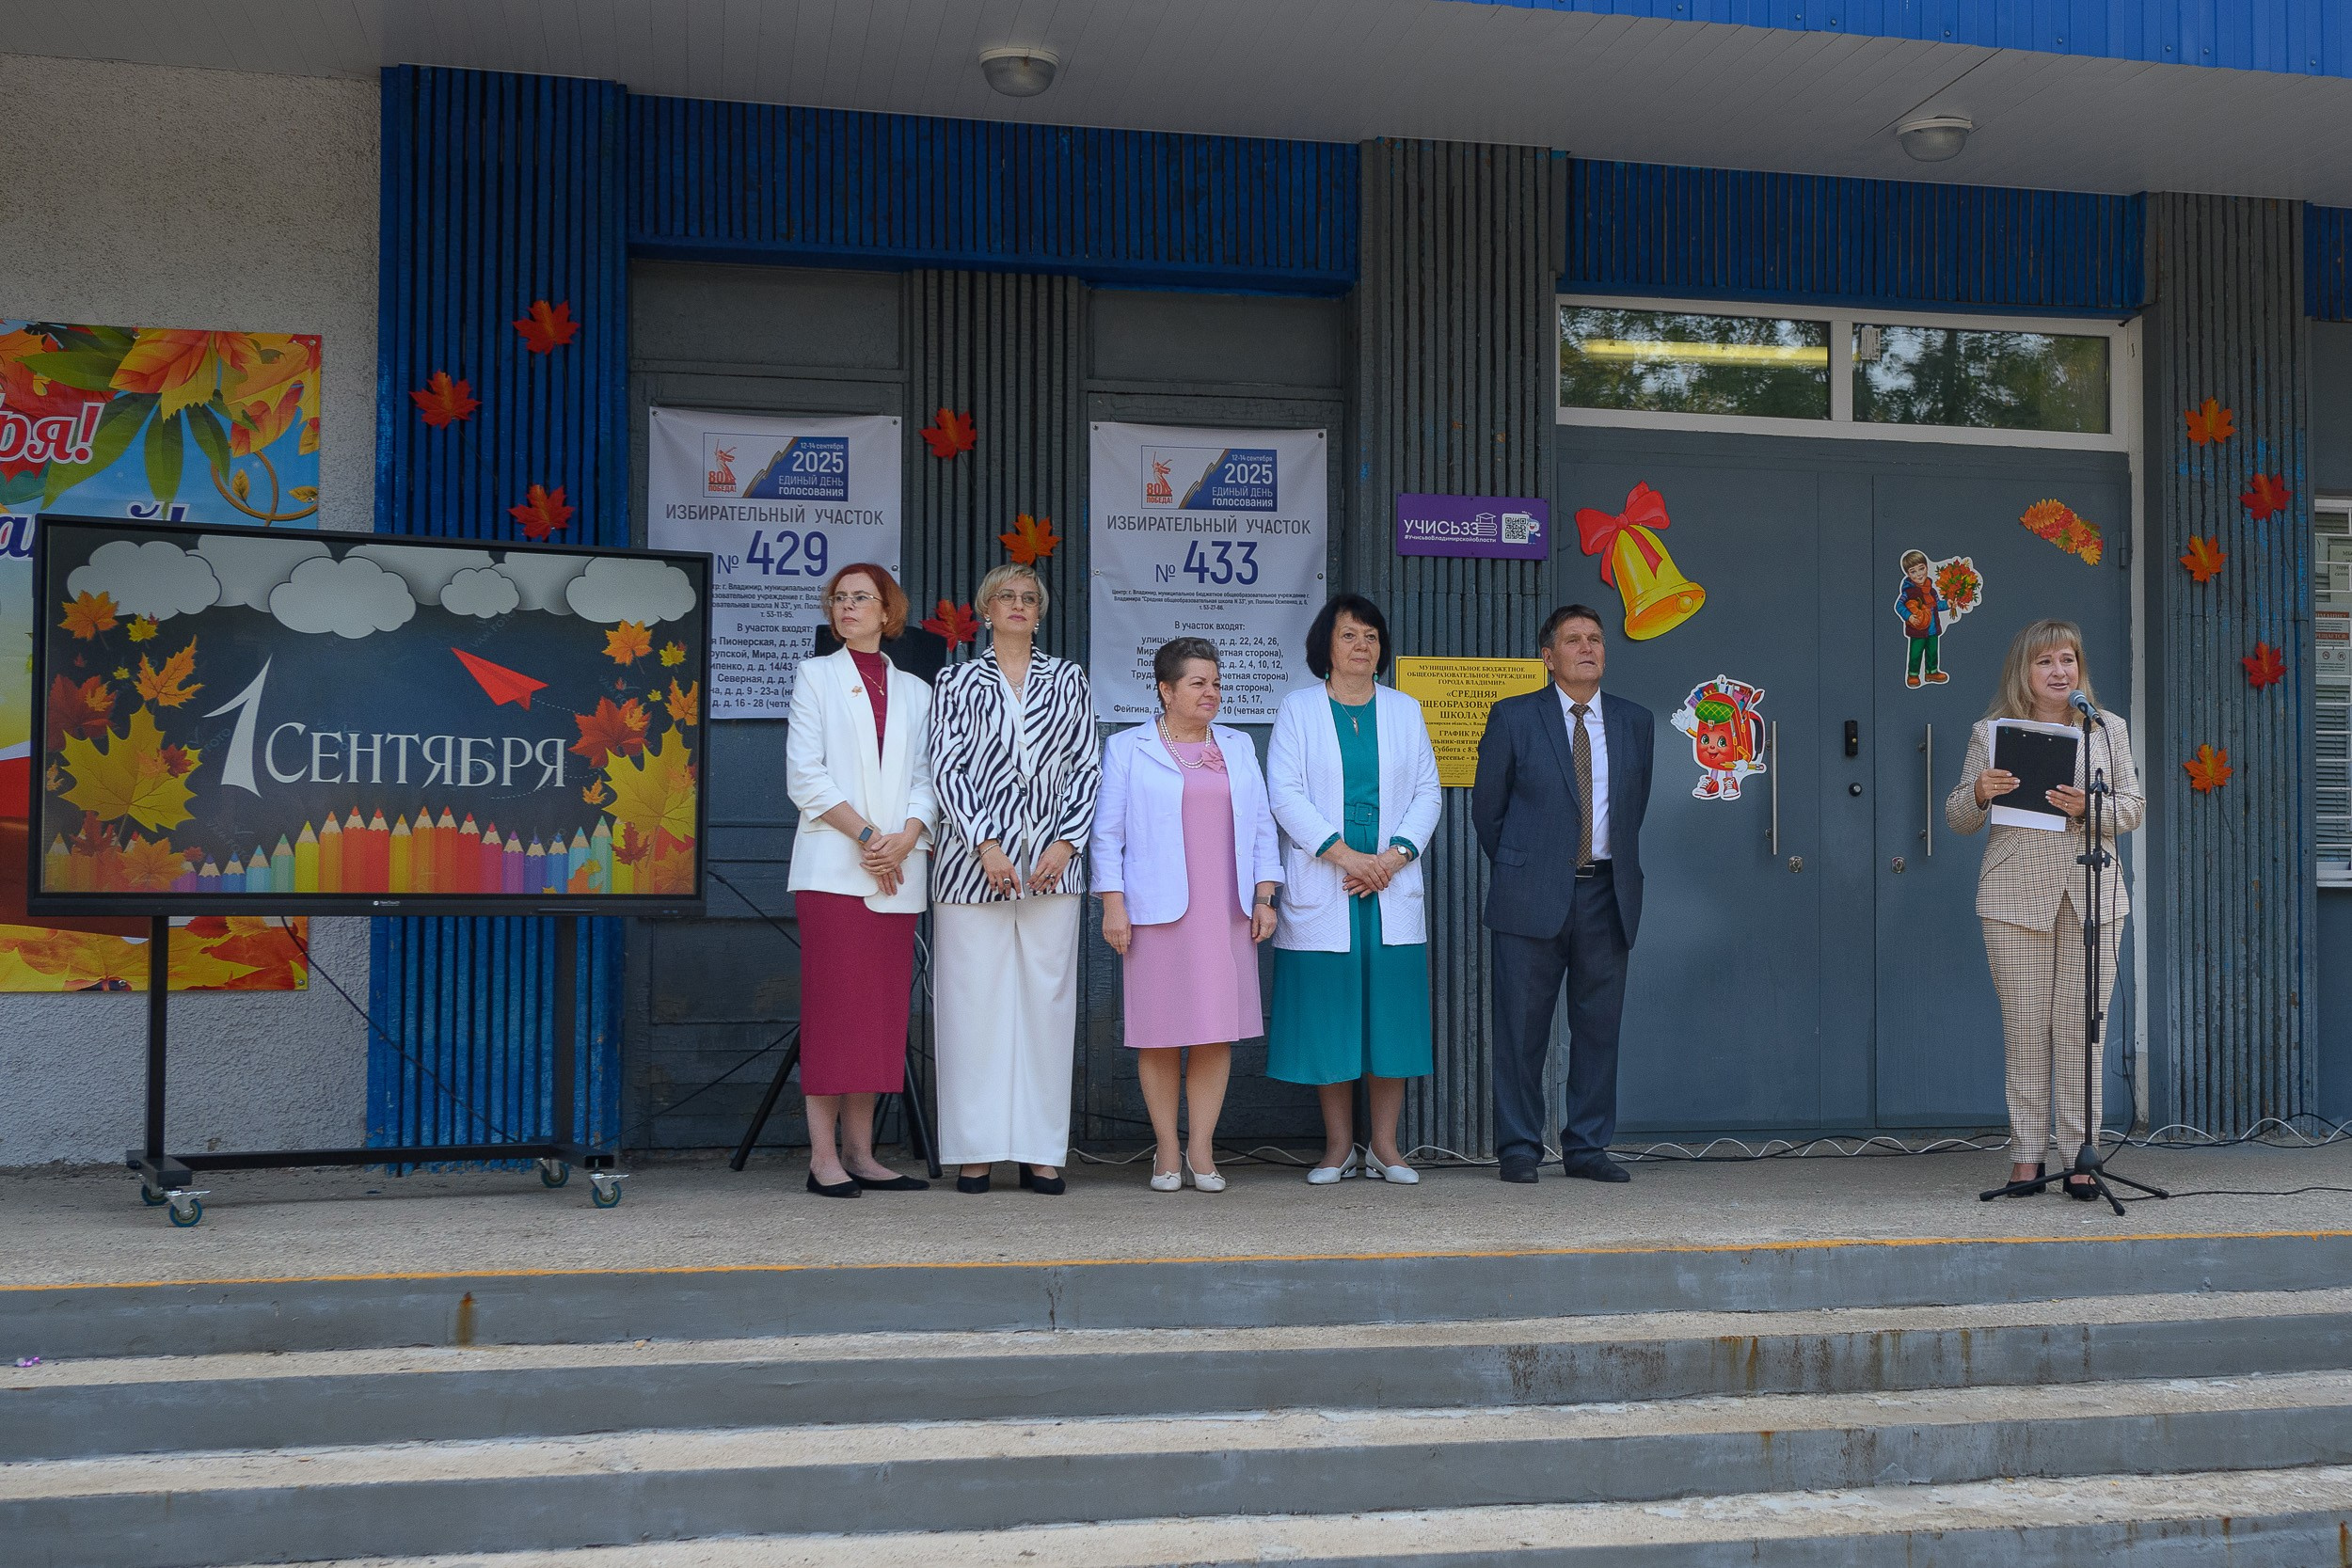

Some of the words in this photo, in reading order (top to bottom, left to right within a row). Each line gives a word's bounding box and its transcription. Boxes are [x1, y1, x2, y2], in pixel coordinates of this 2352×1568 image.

[816, 442, 845, 451] сентября
[792, 451, 845, 473] 2025
[707, 471, 724, 483] 80
[1224, 464, 1273, 485] 2025
[778, 474, 818, 485] ЕДИНЫЙ
[819, 476, 845, 487] ДЕНЬ
[707, 484, 737, 493] ПОБЕДА!
[1146, 483, 1161, 495] 80
[1212, 485, 1248, 497] ЕДИНЫЙ
[1250, 487, 1274, 499] ДЕНЬ
[1146, 497, 1173, 505] ПОБЕДА!
[666, 503, 806, 523] ИЗБИРАТЕЛЬНЫЙ
[815, 508, 884, 526] УЧАСТОК
[1107, 515, 1238, 533] ИЗБИРАТЕЛЬНЫЙ
[1246, 518, 1311, 534] УЧАСТОК
[718, 554, 739, 575] №
[746, 530, 828, 577] 429
[1155, 564, 1176, 583] №
[1183, 540, 1259, 585] 433
[764, 585, 817, 594] муниципальное
[757, 594, 799, 603] учреждение
[737, 623, 744, 632] В
[744, 626, 781, 634] участок
[782, 626, 814, 634] входят:
[1174, 620, 1181, 629] В
[1182, 622, 1215, 631] участок
[1216, 623, 1246, 631] входят:
[719, 637, 777, 647] Пионерская,
[1239, 637, 1252, 646] 22,
[1253, 637, 1265, 646] 24,
[1267, 637, 1279, 646] 26,
[753, 650, 780, 660] Мира,
[1245, 649, 1284, 658] сторона),
[770, 662, 793, 671] 14/43
[1239, 659, 1247, 669] 2,
[1248, 660, 1256, 669] 4,
[1258, 660, 1270, 670] 10,
[1272, 660, 1283, 670] 12,
[1419, 664, 1481, 673] МУНИЦИПАЛЬНОЕ
[717, 673, 765, 685] Северная,
[1252, 672, 1289, 682] сторона)
[746, 687, 753, 695] 9
[1235, 683, 1274, 693] сторона),
[1446, 689, 1498, 699] «СРЕДНЯЯ
[735, 699, 746, 707] 16
[753, 699, 764, 707] 28
[1237, 695, 1249, 705] 15,
[1251, 695, 1263, 705] 17,
[1113, 705, 1152, 715] Фейгина,
[1222, 705, 1232, 715] 10
[1233, 705, 1264, 717] (четная
[1439, 711, 1478, 720] ШКОЛА
[201, 652, 274, 799] 1
[265, 721, 566, 792] СЕНТЯБРЯ
[1433, 746, 1461, 754] Суббота
